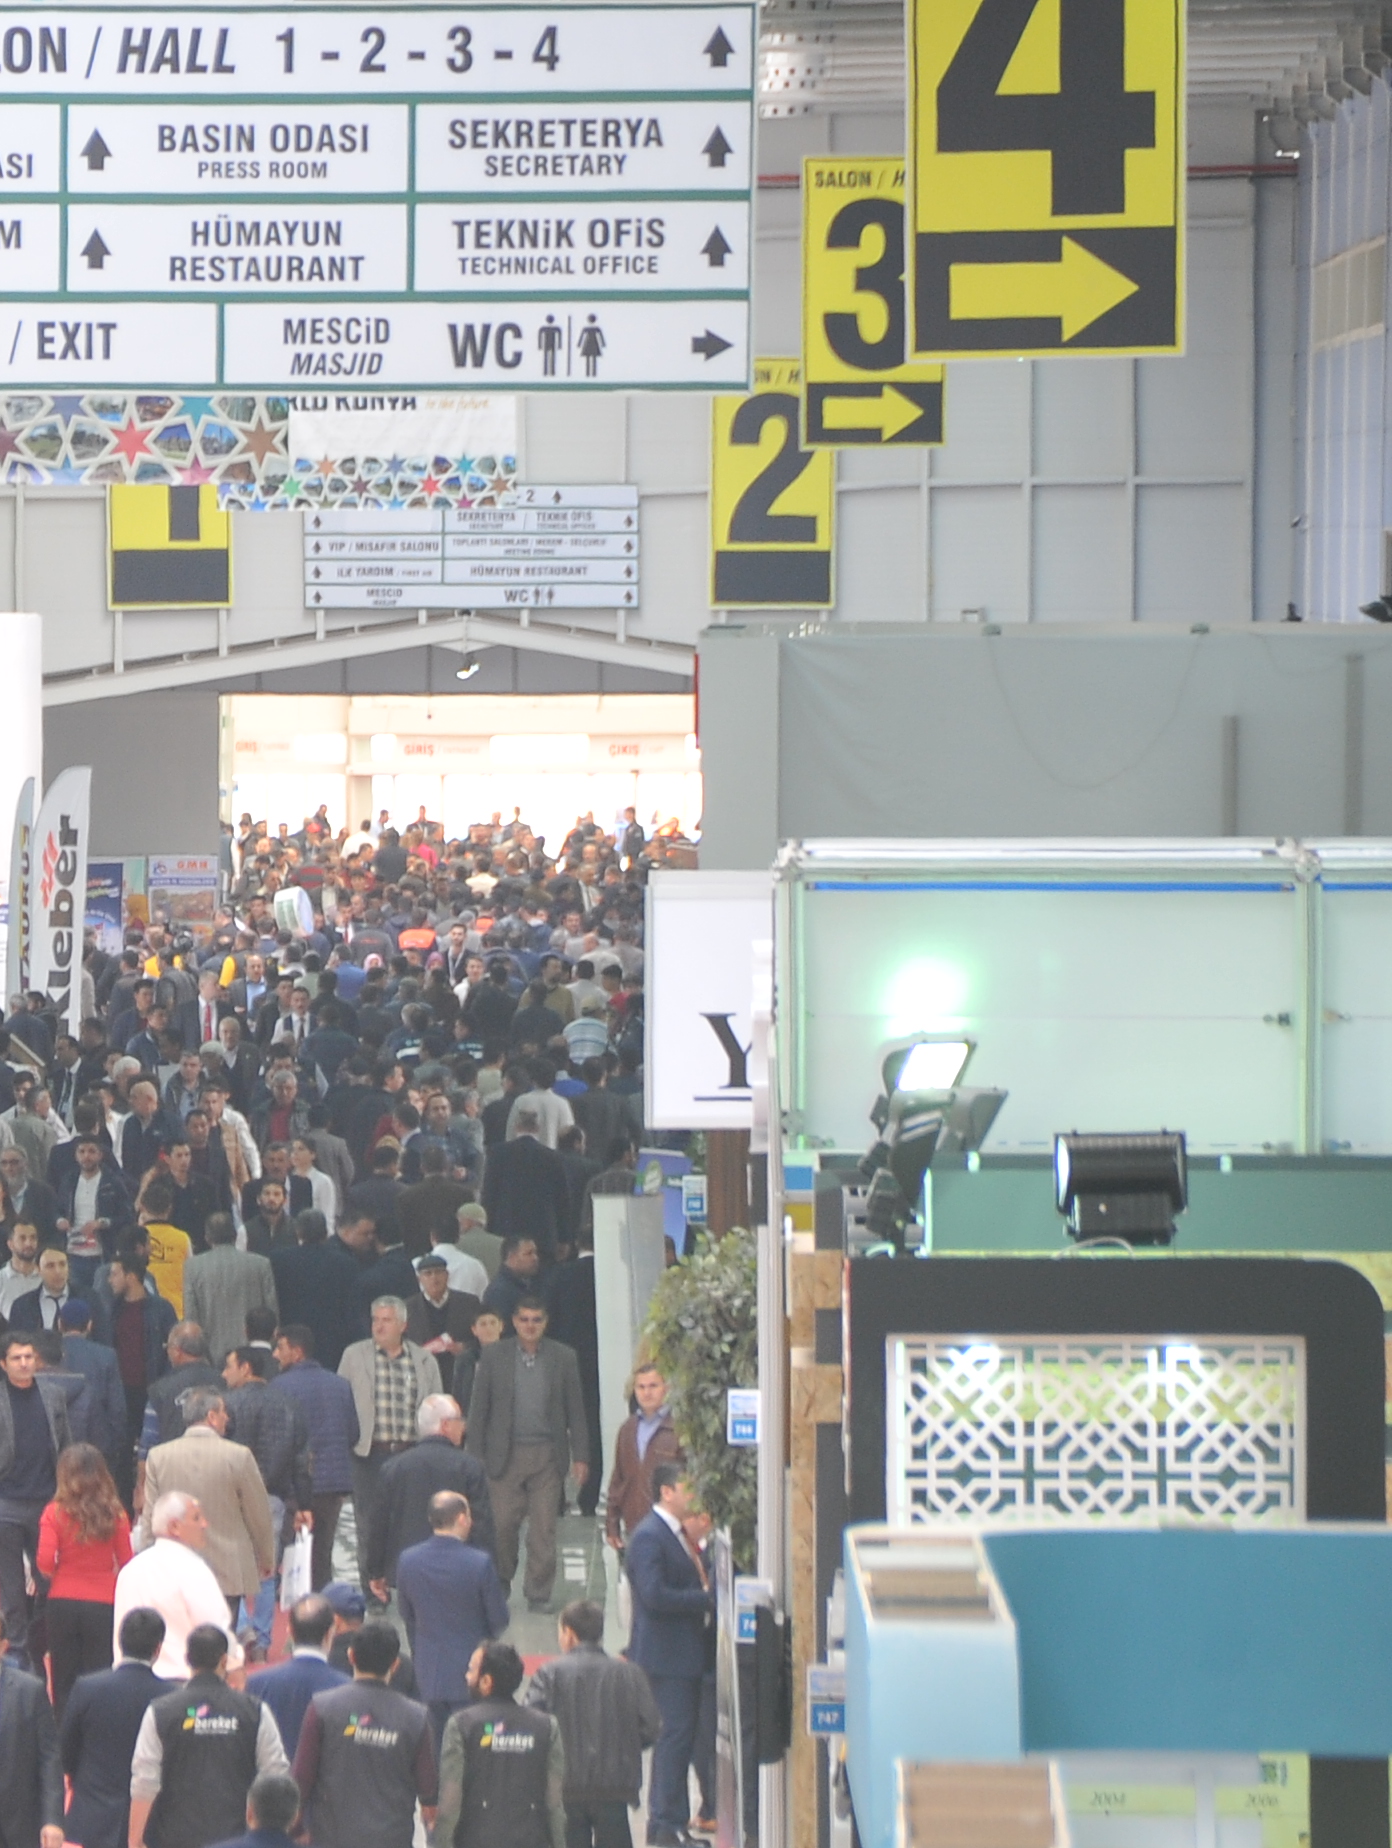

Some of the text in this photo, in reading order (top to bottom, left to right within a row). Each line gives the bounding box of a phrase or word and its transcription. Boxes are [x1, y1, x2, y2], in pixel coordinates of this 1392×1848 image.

[85, 26, 103, 80] /
[116, 27, 238, 75] HALL
[276, 27, 295, 75] 1
[359, 27, 387, 74] 2
[446, 26, 474, 74] 3
[532, 26, 560, 73] 4
[936, 0, 1157, 217] 4
[157, 124, 370, 153] BASIN ODASI
[448, 118, 664, 150] SEKRETERYA
[198, 161, 328, 179] PRESS ROOM
[484, 154, 627, 177] SECRETARY
[815, 170, 871, 188] SALON
[190, 214, 343, 247] HÜMAYUN
[169, 255, 365, 283] RESTAURANT
[459, 255, 659, 276] TECHNICAL OFFICE
[823, 198, 905, 371] 3
[8, 320, 23, 366] /
[37, 321, 118, 361] EXIT
[448, 322, 523, 370] WC
[290, 352, 383, 376] MASJID
[727, 393, 818, 545] 2
[504, 589, 529, 603] WC
[195, 1716, 239, 1731] bereket
[355, 1726, 399, 1746] bereket
[492, 1732, 535, 1749] bereket
